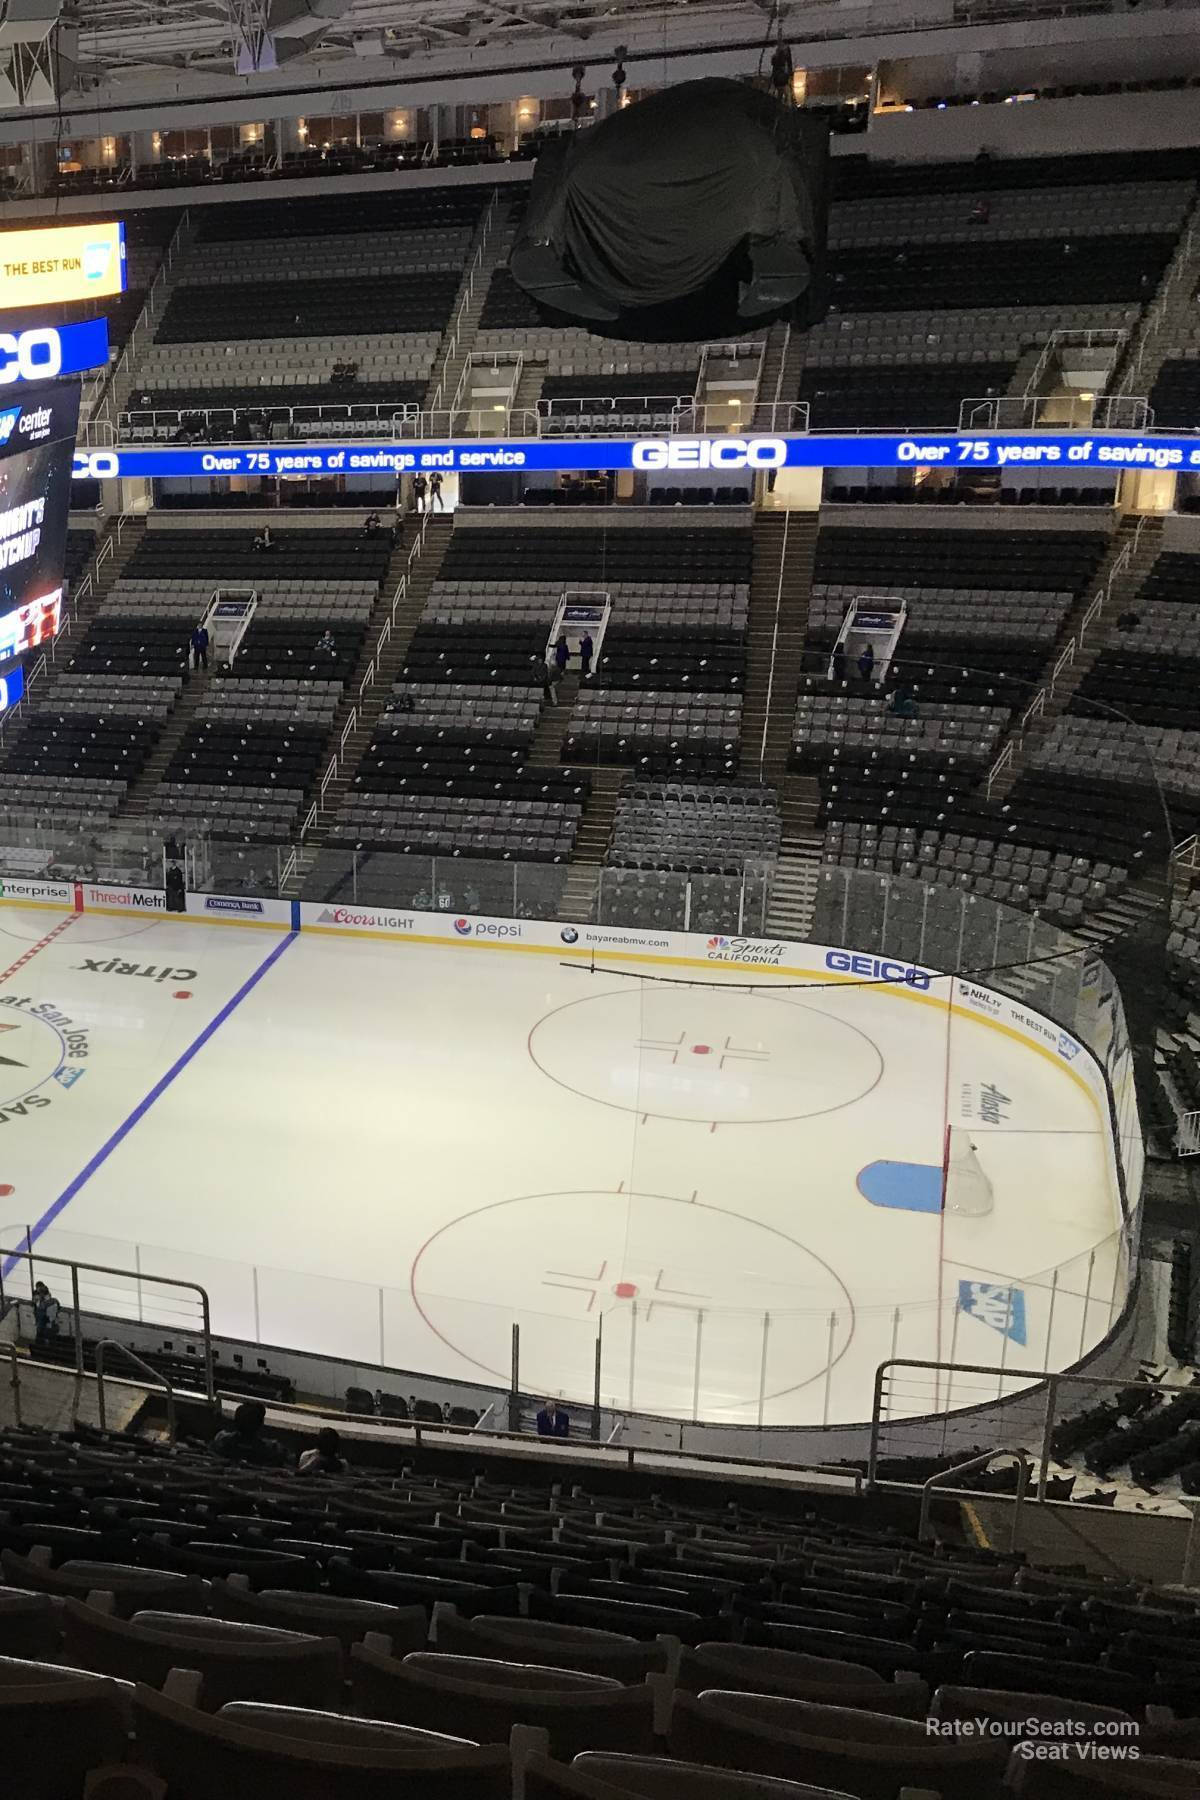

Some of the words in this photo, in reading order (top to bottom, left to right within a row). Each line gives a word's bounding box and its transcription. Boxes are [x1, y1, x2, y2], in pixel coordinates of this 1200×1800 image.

[3, 263, 29, 277] THE
[32, 259, 60, 274] BEST
[62, 257, 81, 271] RUN
[18, 406, 53, 434] center
[202, 454, 241, 471] Over
[246, 453, 270, 470] 75
[276, 454, 323, 473] years
[327, 451, 345, 468] of
[350, 450, 415, 470] savings
[420, 449, 454, 466] and
[459, 448, 526, 466] service
[631, 438, 788, 469] GEICO
[898, 442, 950, 461] Over
[956, 441, 990, 461] 75
[997, 445, 1061, 465] years
[1068, 441, 1093, 461] of
[1098, 443, 1182, 467] savings
[89, 889, 166, 908] ThreatMetri
[209, 899, 240, 909] Comerica
[241, 901, 260, 911] Bank
[334, 907, 376, 926] Coors
[377, 917, 415, 929] LIGHT
[475, 922, 522, 938] pepsi
[586, 932, 670, 948] bayareabmw.com
[730, 938, 789, 956] Sports
[77, 957, 198, 983] CITRIX
[707, 951, 780, 965] CALIFORNIA
[825, 951, 930, 991] GEICO
[30, 1003, 73, 1027] San
[62, 1028, 89, 1058] Jose
[1011, 1010, 1025, 1023] THE
[1026, 1018, 1042, 1032] BEST
[1043, 1028, 1057, 1042] RUN
[970, 1282, 1015, 1330] SAP
